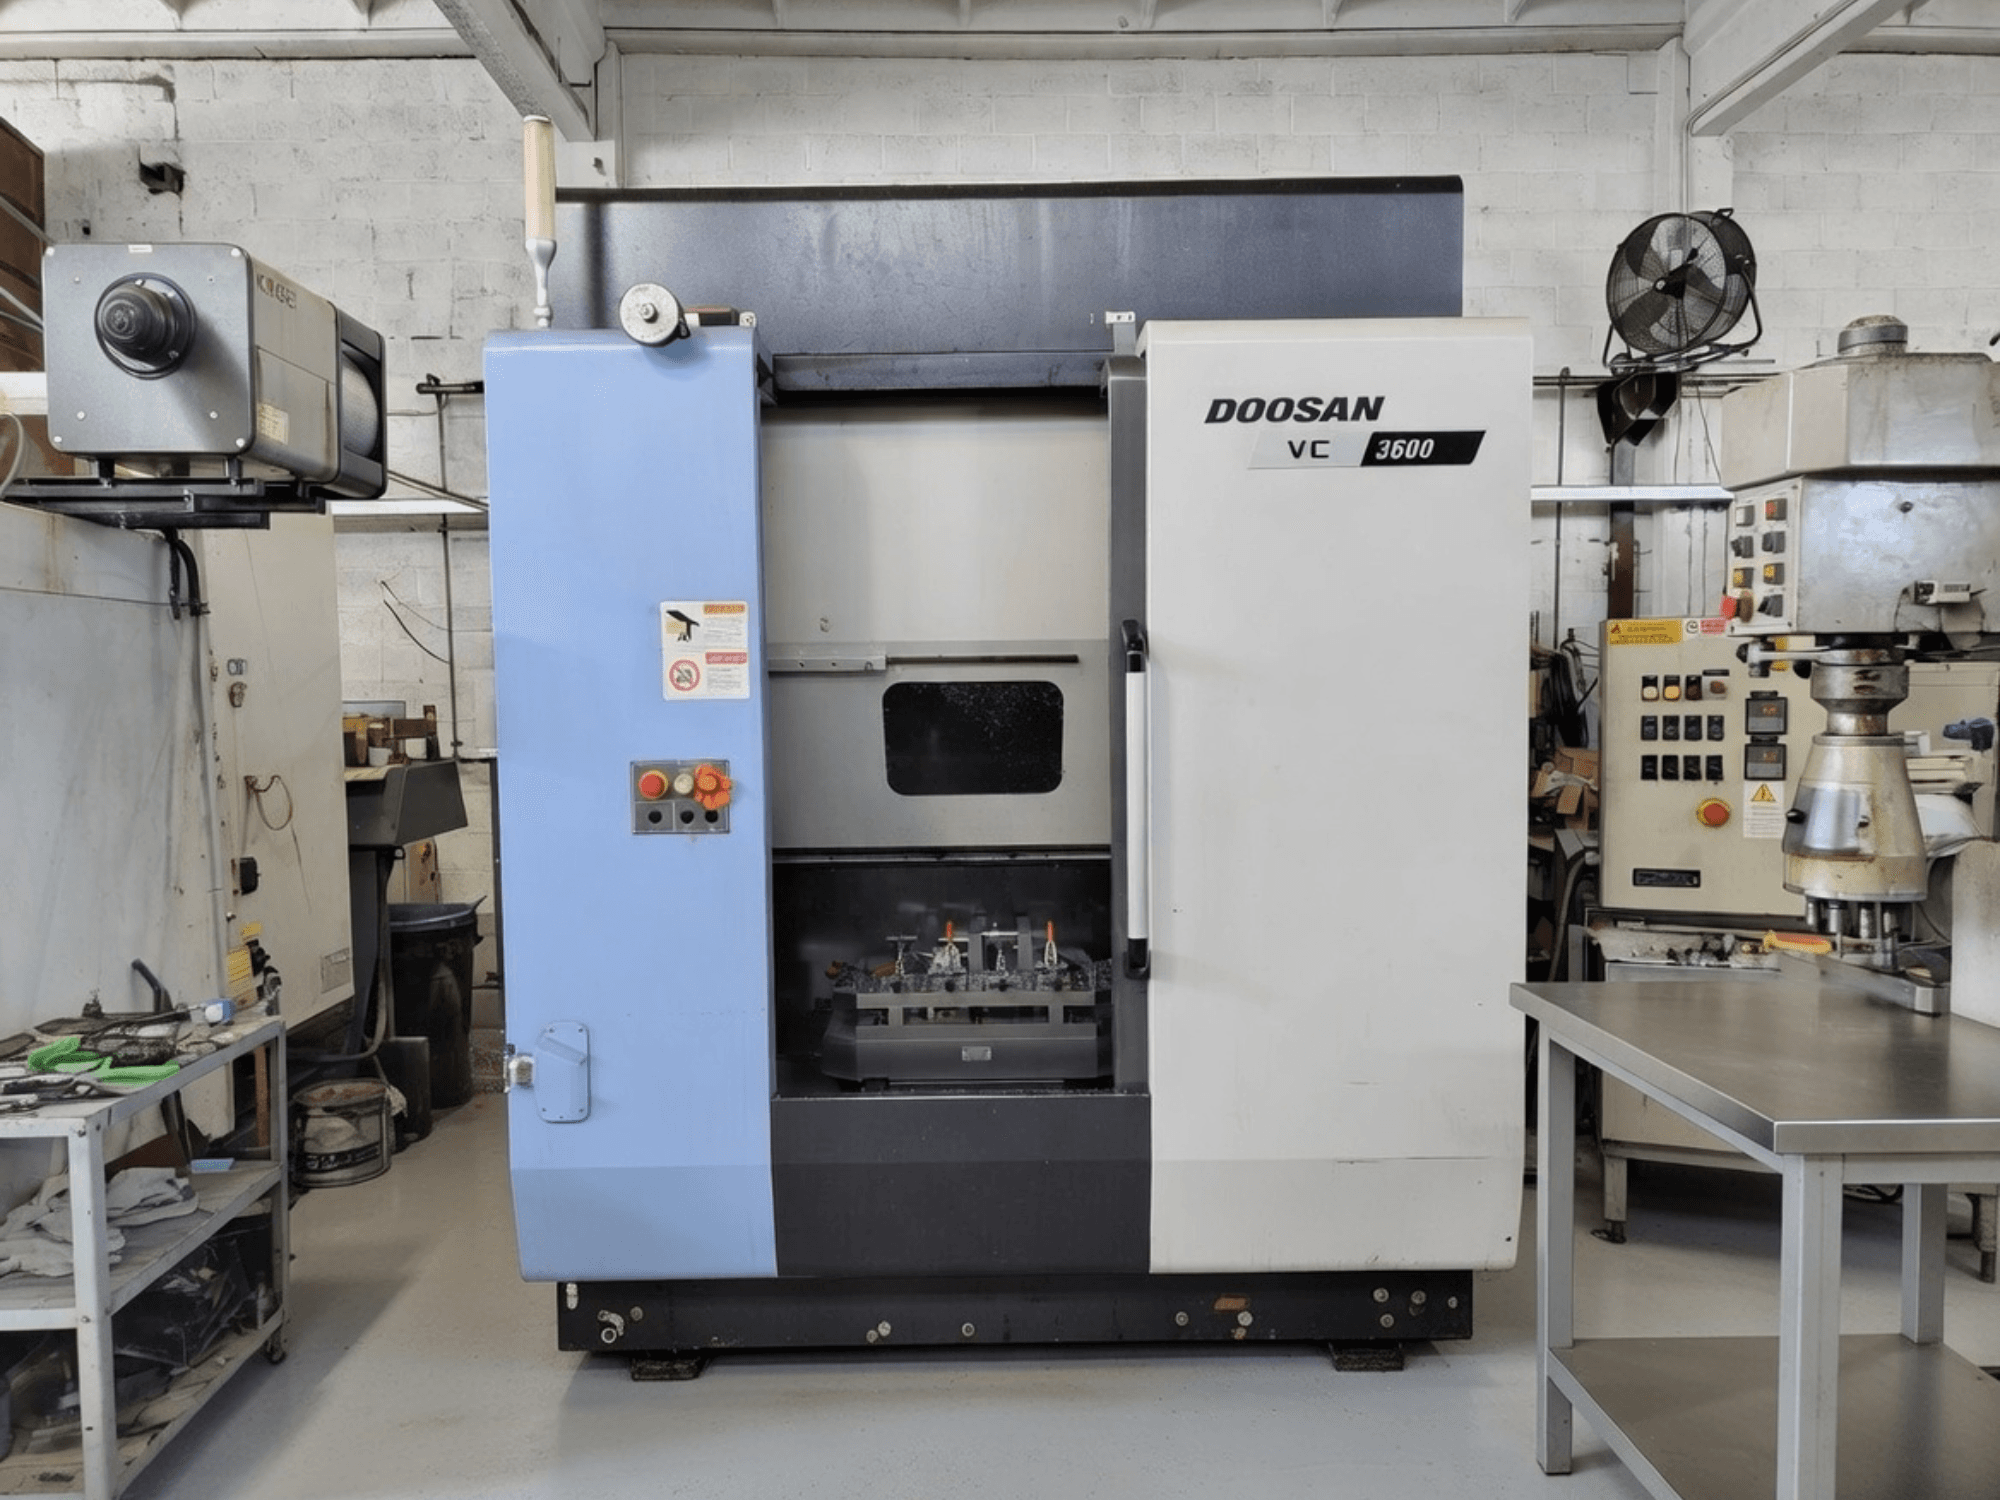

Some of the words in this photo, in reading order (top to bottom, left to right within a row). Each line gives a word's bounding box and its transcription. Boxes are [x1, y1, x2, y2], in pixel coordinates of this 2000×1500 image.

[1204, 396, 1385, 423] DOOSAN
[1287, 440, 1330, 459] VC
[1375, 438, 1434, 459] 3600
